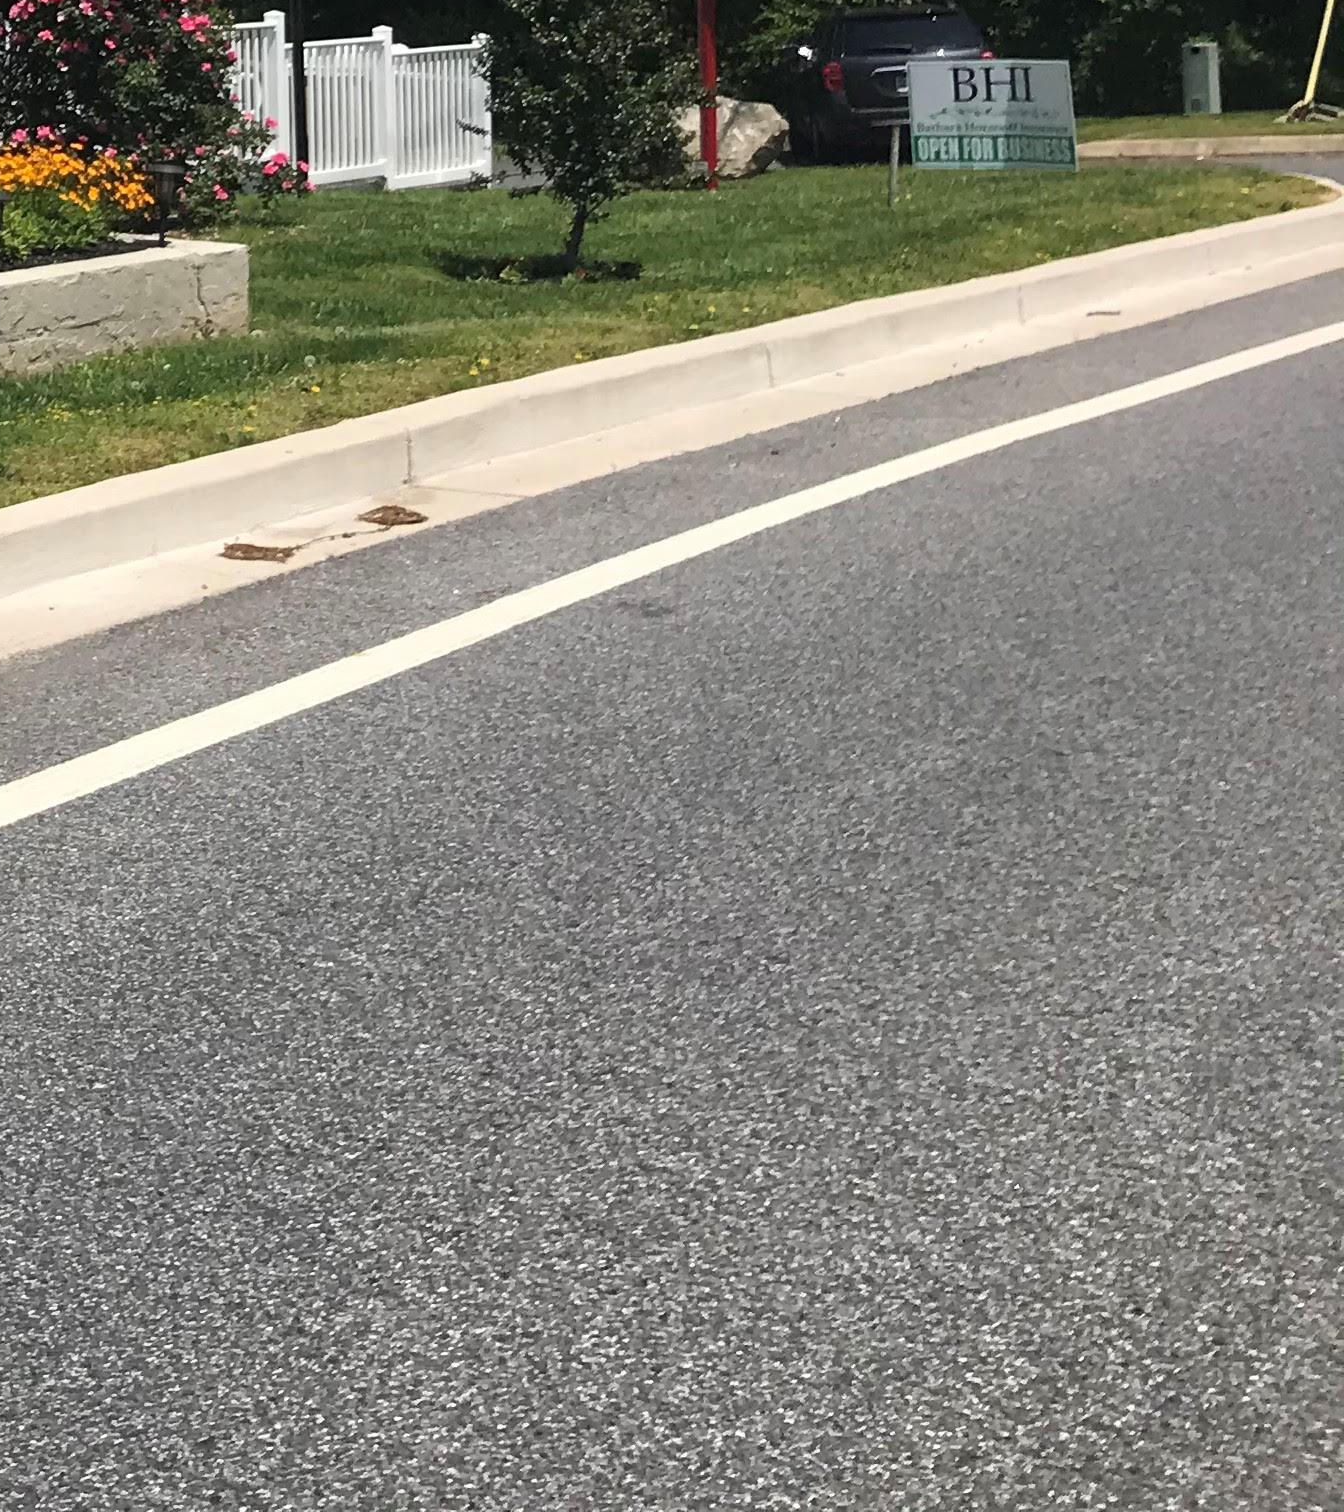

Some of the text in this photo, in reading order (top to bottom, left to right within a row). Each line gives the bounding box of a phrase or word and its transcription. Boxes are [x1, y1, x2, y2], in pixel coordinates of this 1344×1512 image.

[949, 66, 1034, 103] BHI
[917, 137, 1072, 162] OPEN FOR BUSINESS
